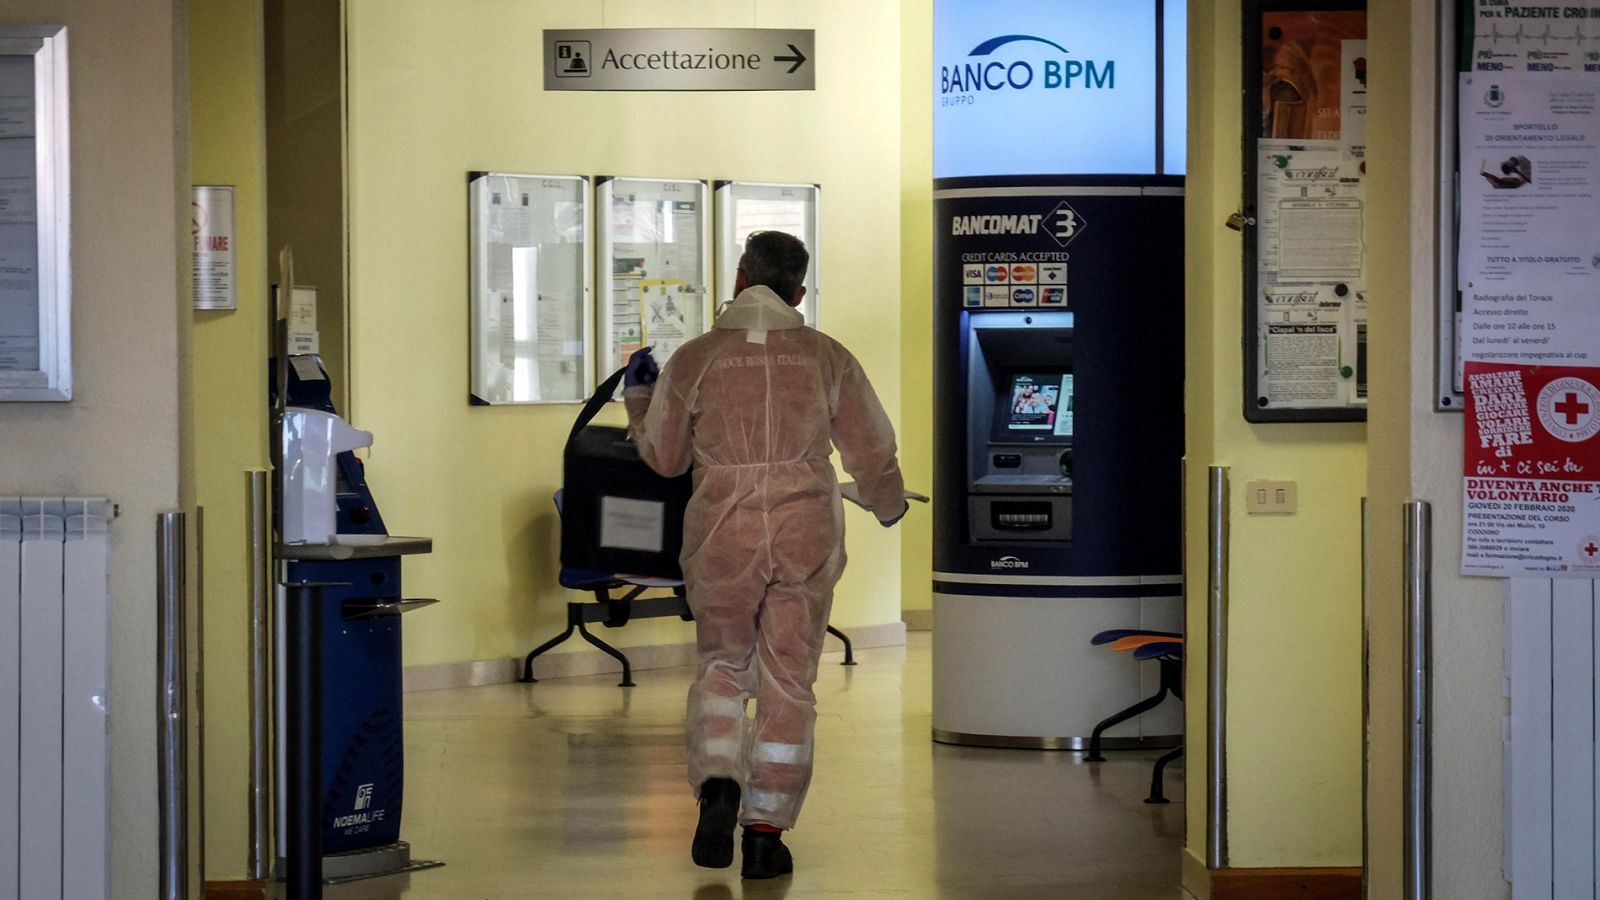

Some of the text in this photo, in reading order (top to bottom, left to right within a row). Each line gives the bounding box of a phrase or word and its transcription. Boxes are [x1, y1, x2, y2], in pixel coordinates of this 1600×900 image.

[1504, 7, 1559, 18] PAZIENTE
[601, 47, 761, 70] Accettazione
[1477, 62, 1504, 71] MENO
[1527, 63, 1554, 72] MENO
[941, 60, 1115, 94] BANCO BPM
[1513, 123, 1558, 131] SPORTELLO
[952, 214, 1042, 236] BANCOMAT
[962, 252, 1070, 262] CREDIT CARDS ACCEPTED
[965, 269, 982, 279] VISA
[1473, 294, 1514, 302] Radiografia
[1473, 308, 1529, 316] Accesso diretto
[1472, 351, 1518, 359] regolarizzare
[1520, 351, 1564, 359] impegnativa
[1574, 352, 1587, 360] cup
[1468, 370, 1521, 381] ASCOLTARE
[1470, 377, 1523, 389] AMARE
[1471, 385, 1525, 395] CREDERE
[1472, 391, 1527, 405] DARE
[1475, 401, 1528, 413] RICEVERE
[1475, 409, 1530, 420] GIOCARE
[1477, 417, 1531, 429] VOLARE
[1480, 431, 1534, 449] FARE
[1495, 446, 1513, 458] di
[1467, 480, 1536, 491] DIVENTA
[1540, 483, 1593, 493] ANCHE
[1467, 490, 1569, 503] VOLONTARIO
[1514, 503, 1555, 512] FEBBRAIO
[1557, 505, 1575, 513] 2020
[1468, 513, 1526, 521] PRESENTAZIONE
[1544, 515, 1570, 523] CORSO
[991, 560, 1029, 569] BANCO BPM
[333, 809, 385, 829] NOEMALIFE
